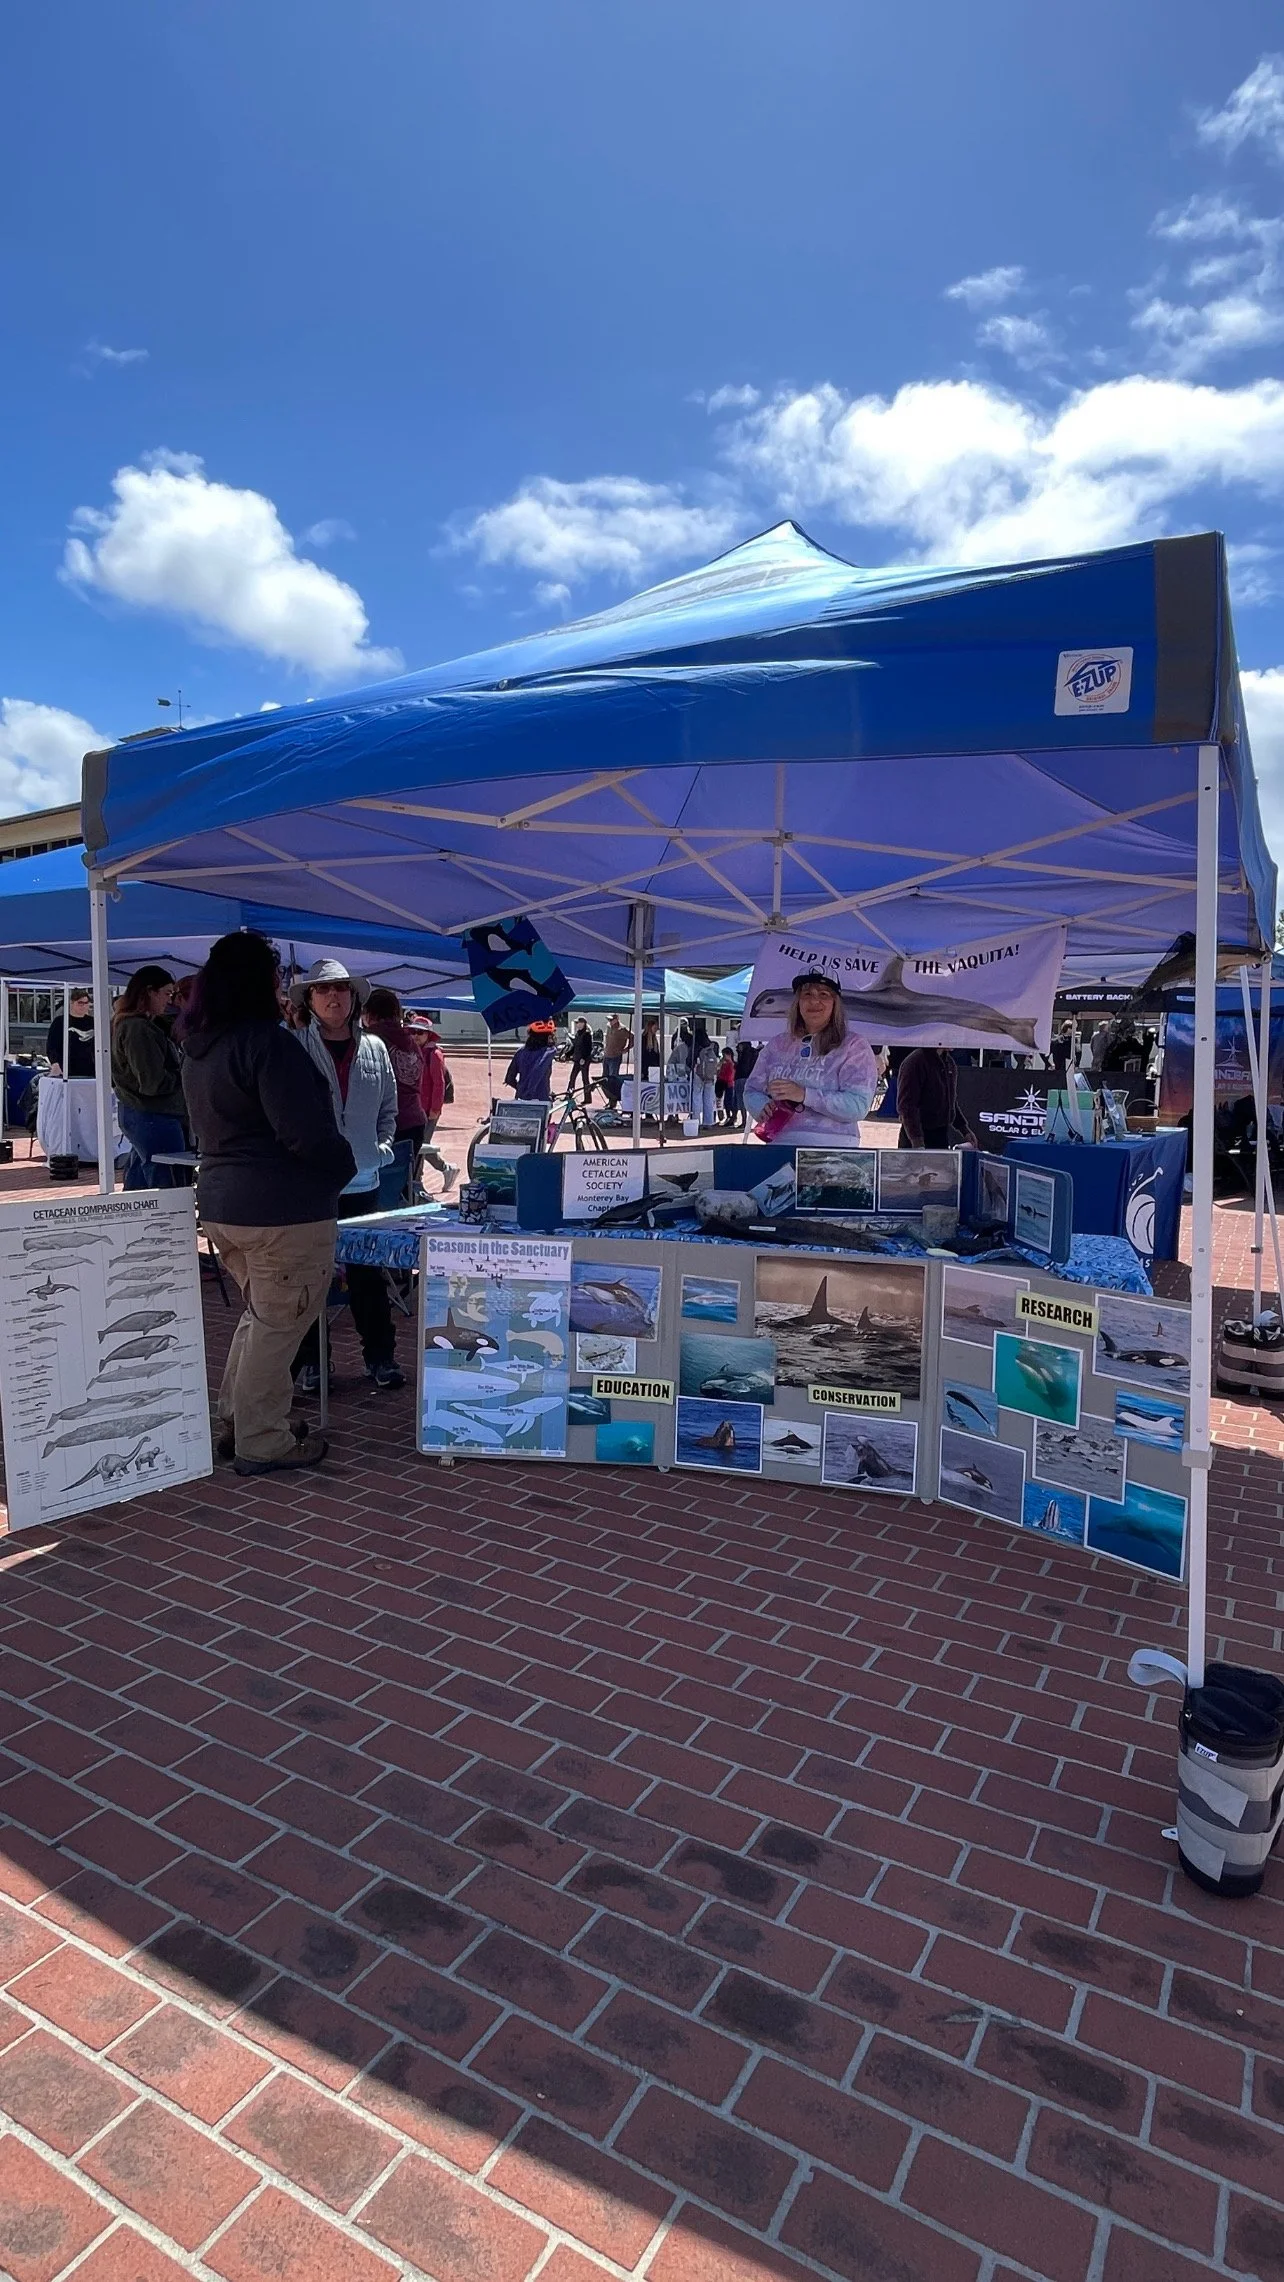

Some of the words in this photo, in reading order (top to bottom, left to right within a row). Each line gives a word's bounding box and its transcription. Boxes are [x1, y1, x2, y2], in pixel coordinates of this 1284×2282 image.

[778, 944, 817, 963] HELP
[822, 955, 841, 970] US
[844, 957, 879, 973] SAVE
[914, 960, 943, 975] THE
[947, 944, 1020, 973] VAQUITA!
[988, 1125, 1019, 1134] SOLAR
[582, 1158, 628, 1167] AMERICAN
[581, 1170, 628, 1179] CETACEAN
[585, 1181, 624, 1190] SOCIETY
[577, 1194, 614, 1203] Monterey
[615, 1194, 630, 1203] Bay
[33, 1208, 77, 1220] CETACEAN
[78, 1202, 132, 1216] COMPARISON
[133, 1200, 159, 1210] CHART
[428, 1238, 477, 1254] Seasons
[479, 1239, 490, 1255] in
[490, 1241, 509, 1256] the
[510, 1242, 570, 1260] Sanctuary
[1021, 1297, 1093, 1328] RESEARCH
[596, 1380, 670, 1399] EDUCATION
[812, 1389, 896, 1407] CONSERVATION
